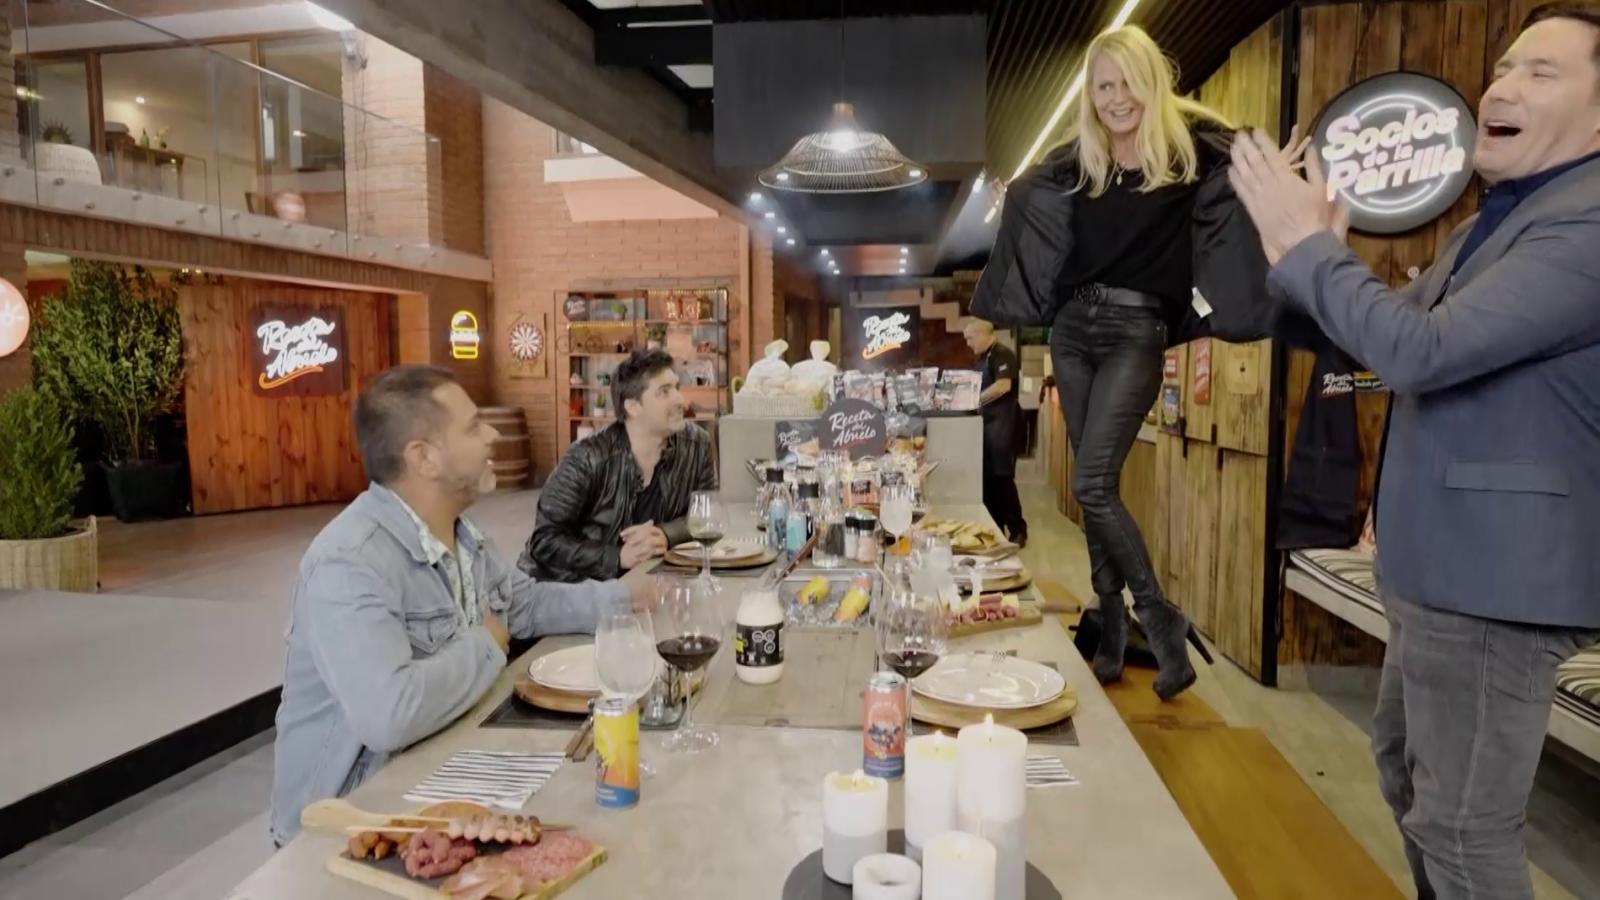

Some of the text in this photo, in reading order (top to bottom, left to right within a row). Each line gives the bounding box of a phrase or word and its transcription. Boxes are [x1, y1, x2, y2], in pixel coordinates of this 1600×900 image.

[1322, 107, 1460, 161] Socios
[1363, 143, 1414, 168] de la
[1327, 144, 1466, 202] Parrilla
[829, 409, 875, 432] Receta
[833, 426, 877, 447] Abuelo
